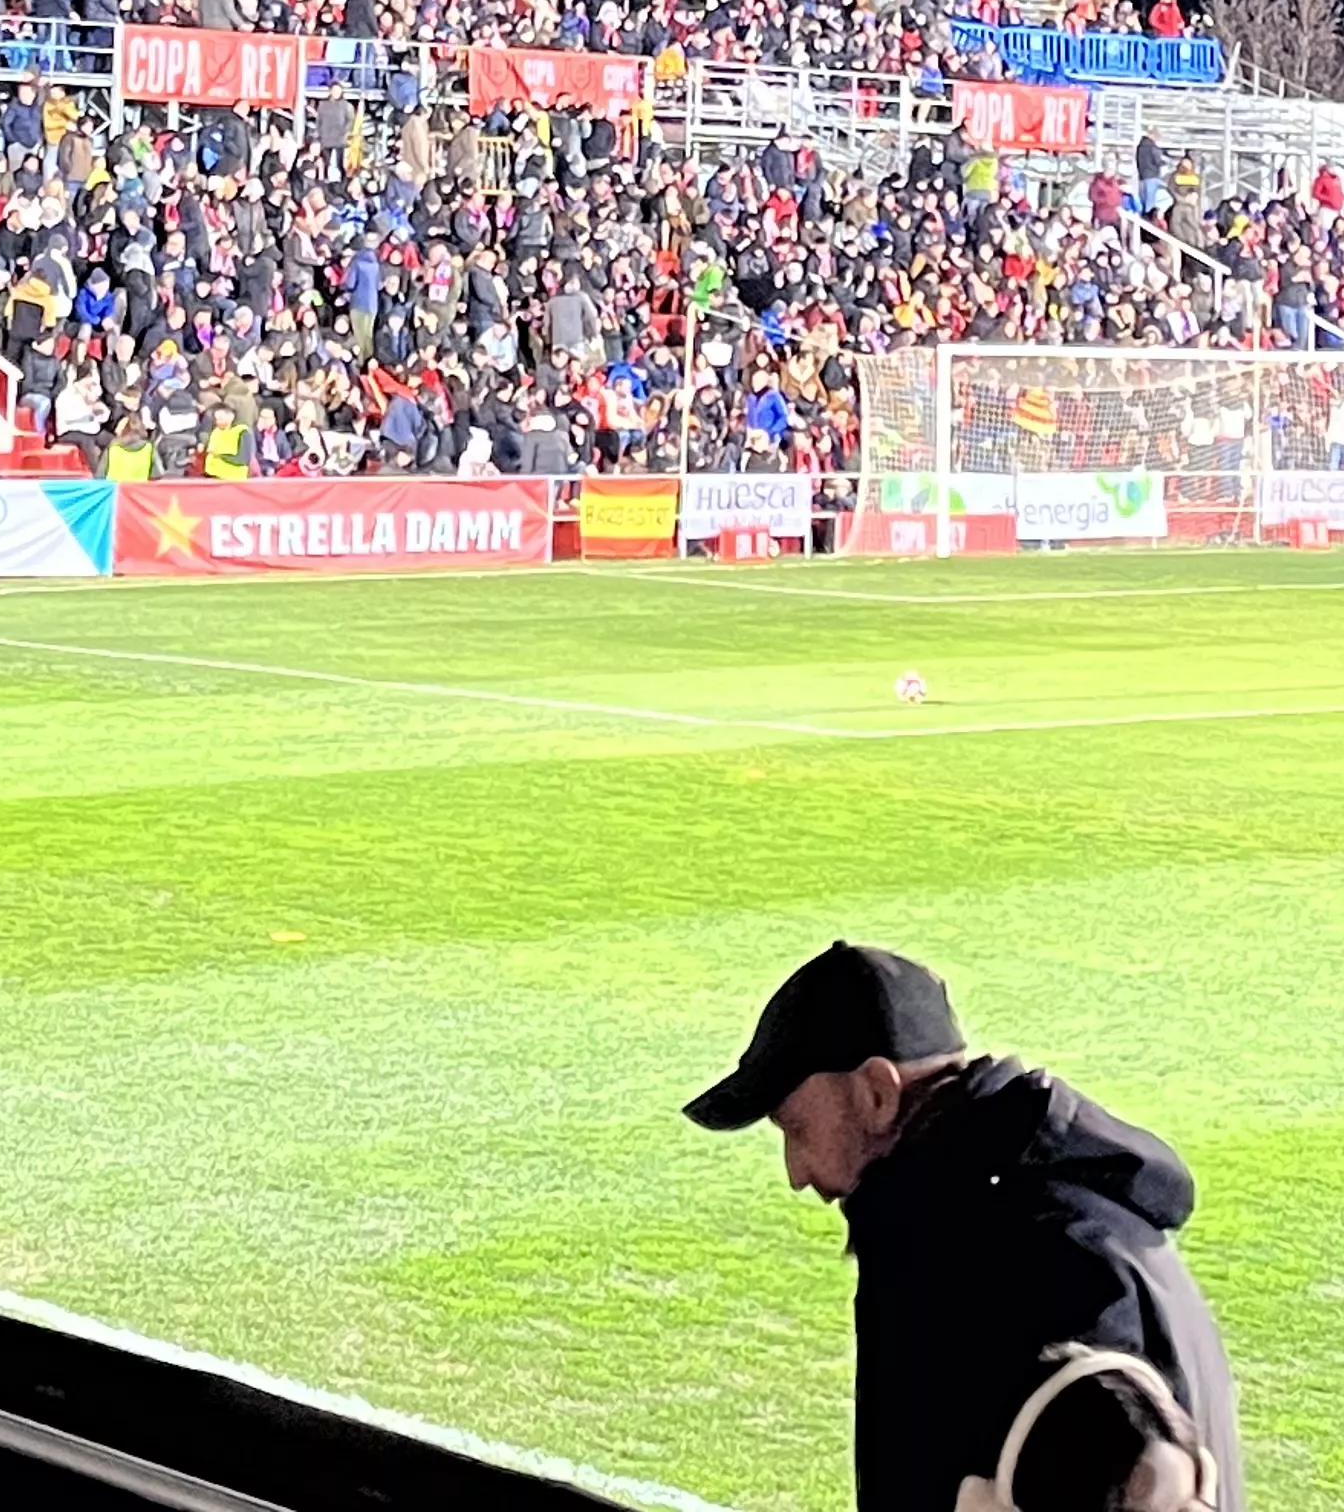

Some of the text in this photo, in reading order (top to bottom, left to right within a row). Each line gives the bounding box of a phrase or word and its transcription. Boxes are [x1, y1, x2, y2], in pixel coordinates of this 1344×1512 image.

[126, 35, 293, 100] COPA REY
[1041, 95, 1082, 145] REY
[209, 509, 524, 558] ESTRELLA DAMM
